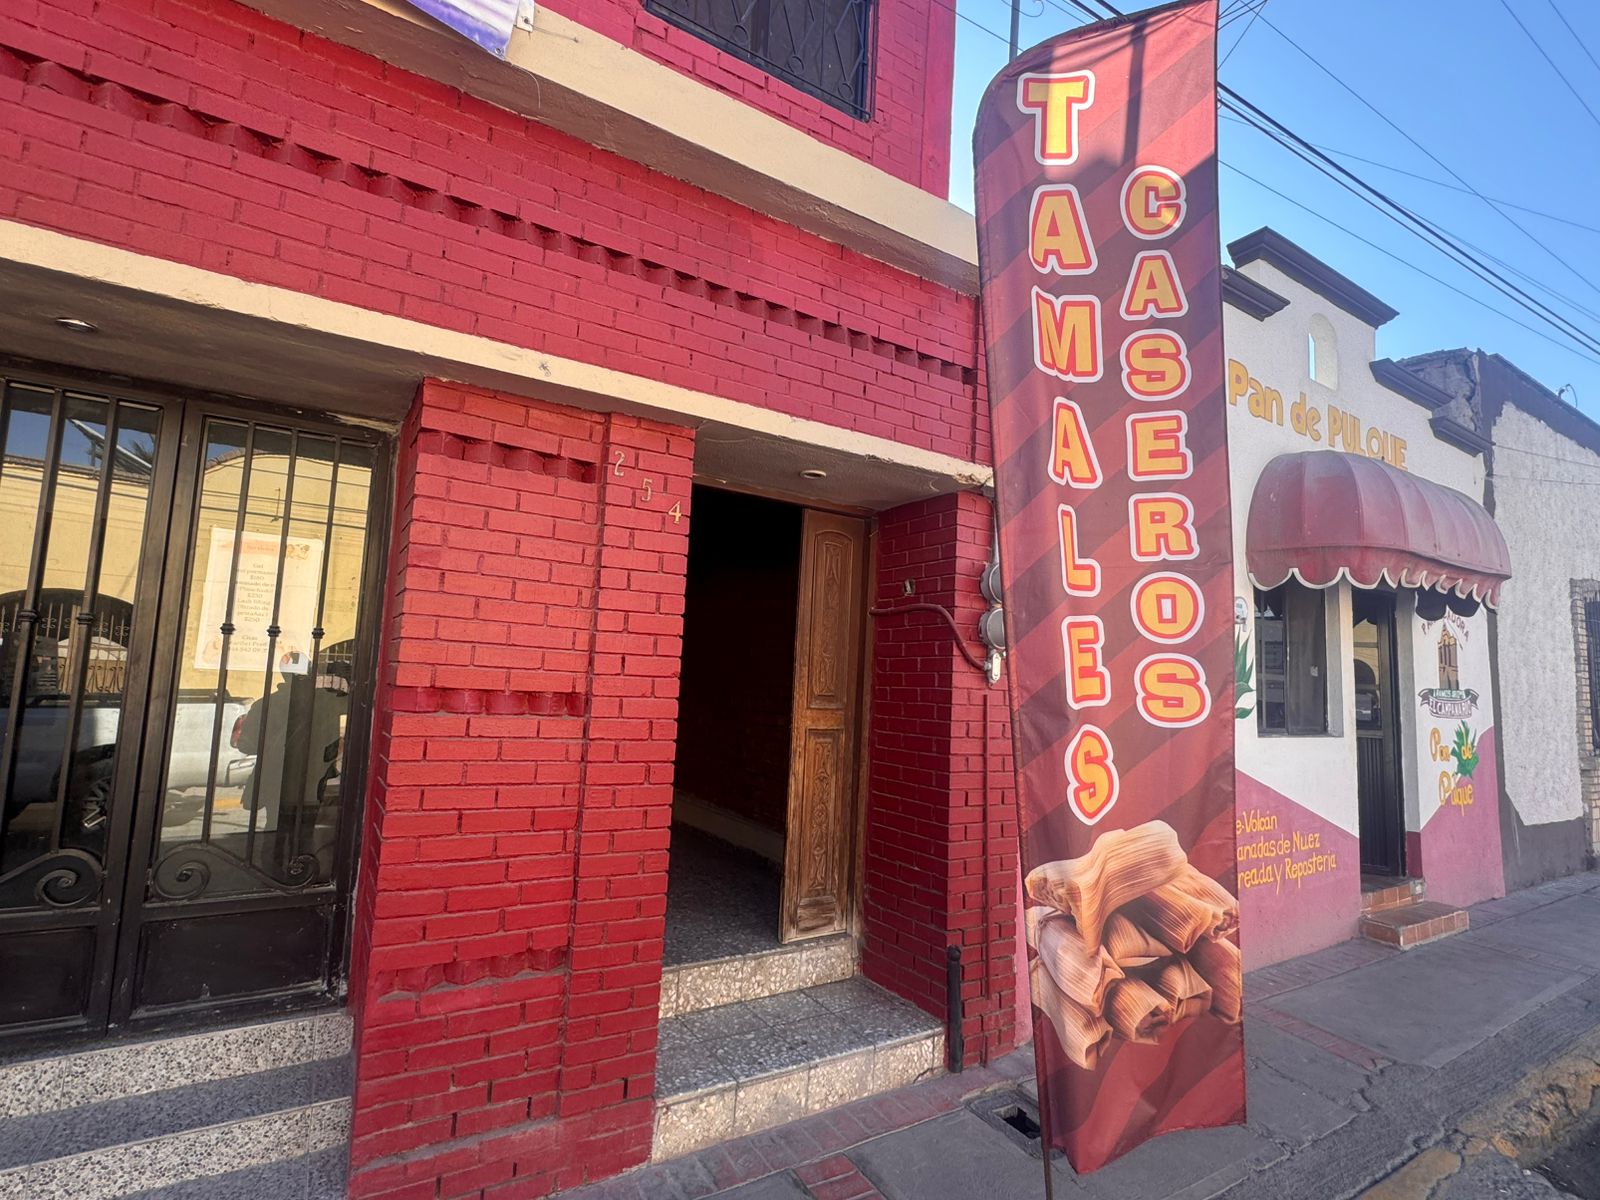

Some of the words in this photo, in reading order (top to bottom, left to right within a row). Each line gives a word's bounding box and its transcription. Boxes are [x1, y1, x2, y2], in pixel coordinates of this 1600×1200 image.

[1228, 358, 1284, 427] Pan
[1290, 392, 1322, 442] de
[1017, 70, 1119, 825] TAMALES
[1120, 165, 1211, 728] CASEROS
[1430, 727, 1450, 762] Pan
[1461, 735, 1473, 761] de
[1277, 833, 1291, 855] de
[1292, 830, 1320, 852] Nuez
[1273, 863, 1283, 895] y
